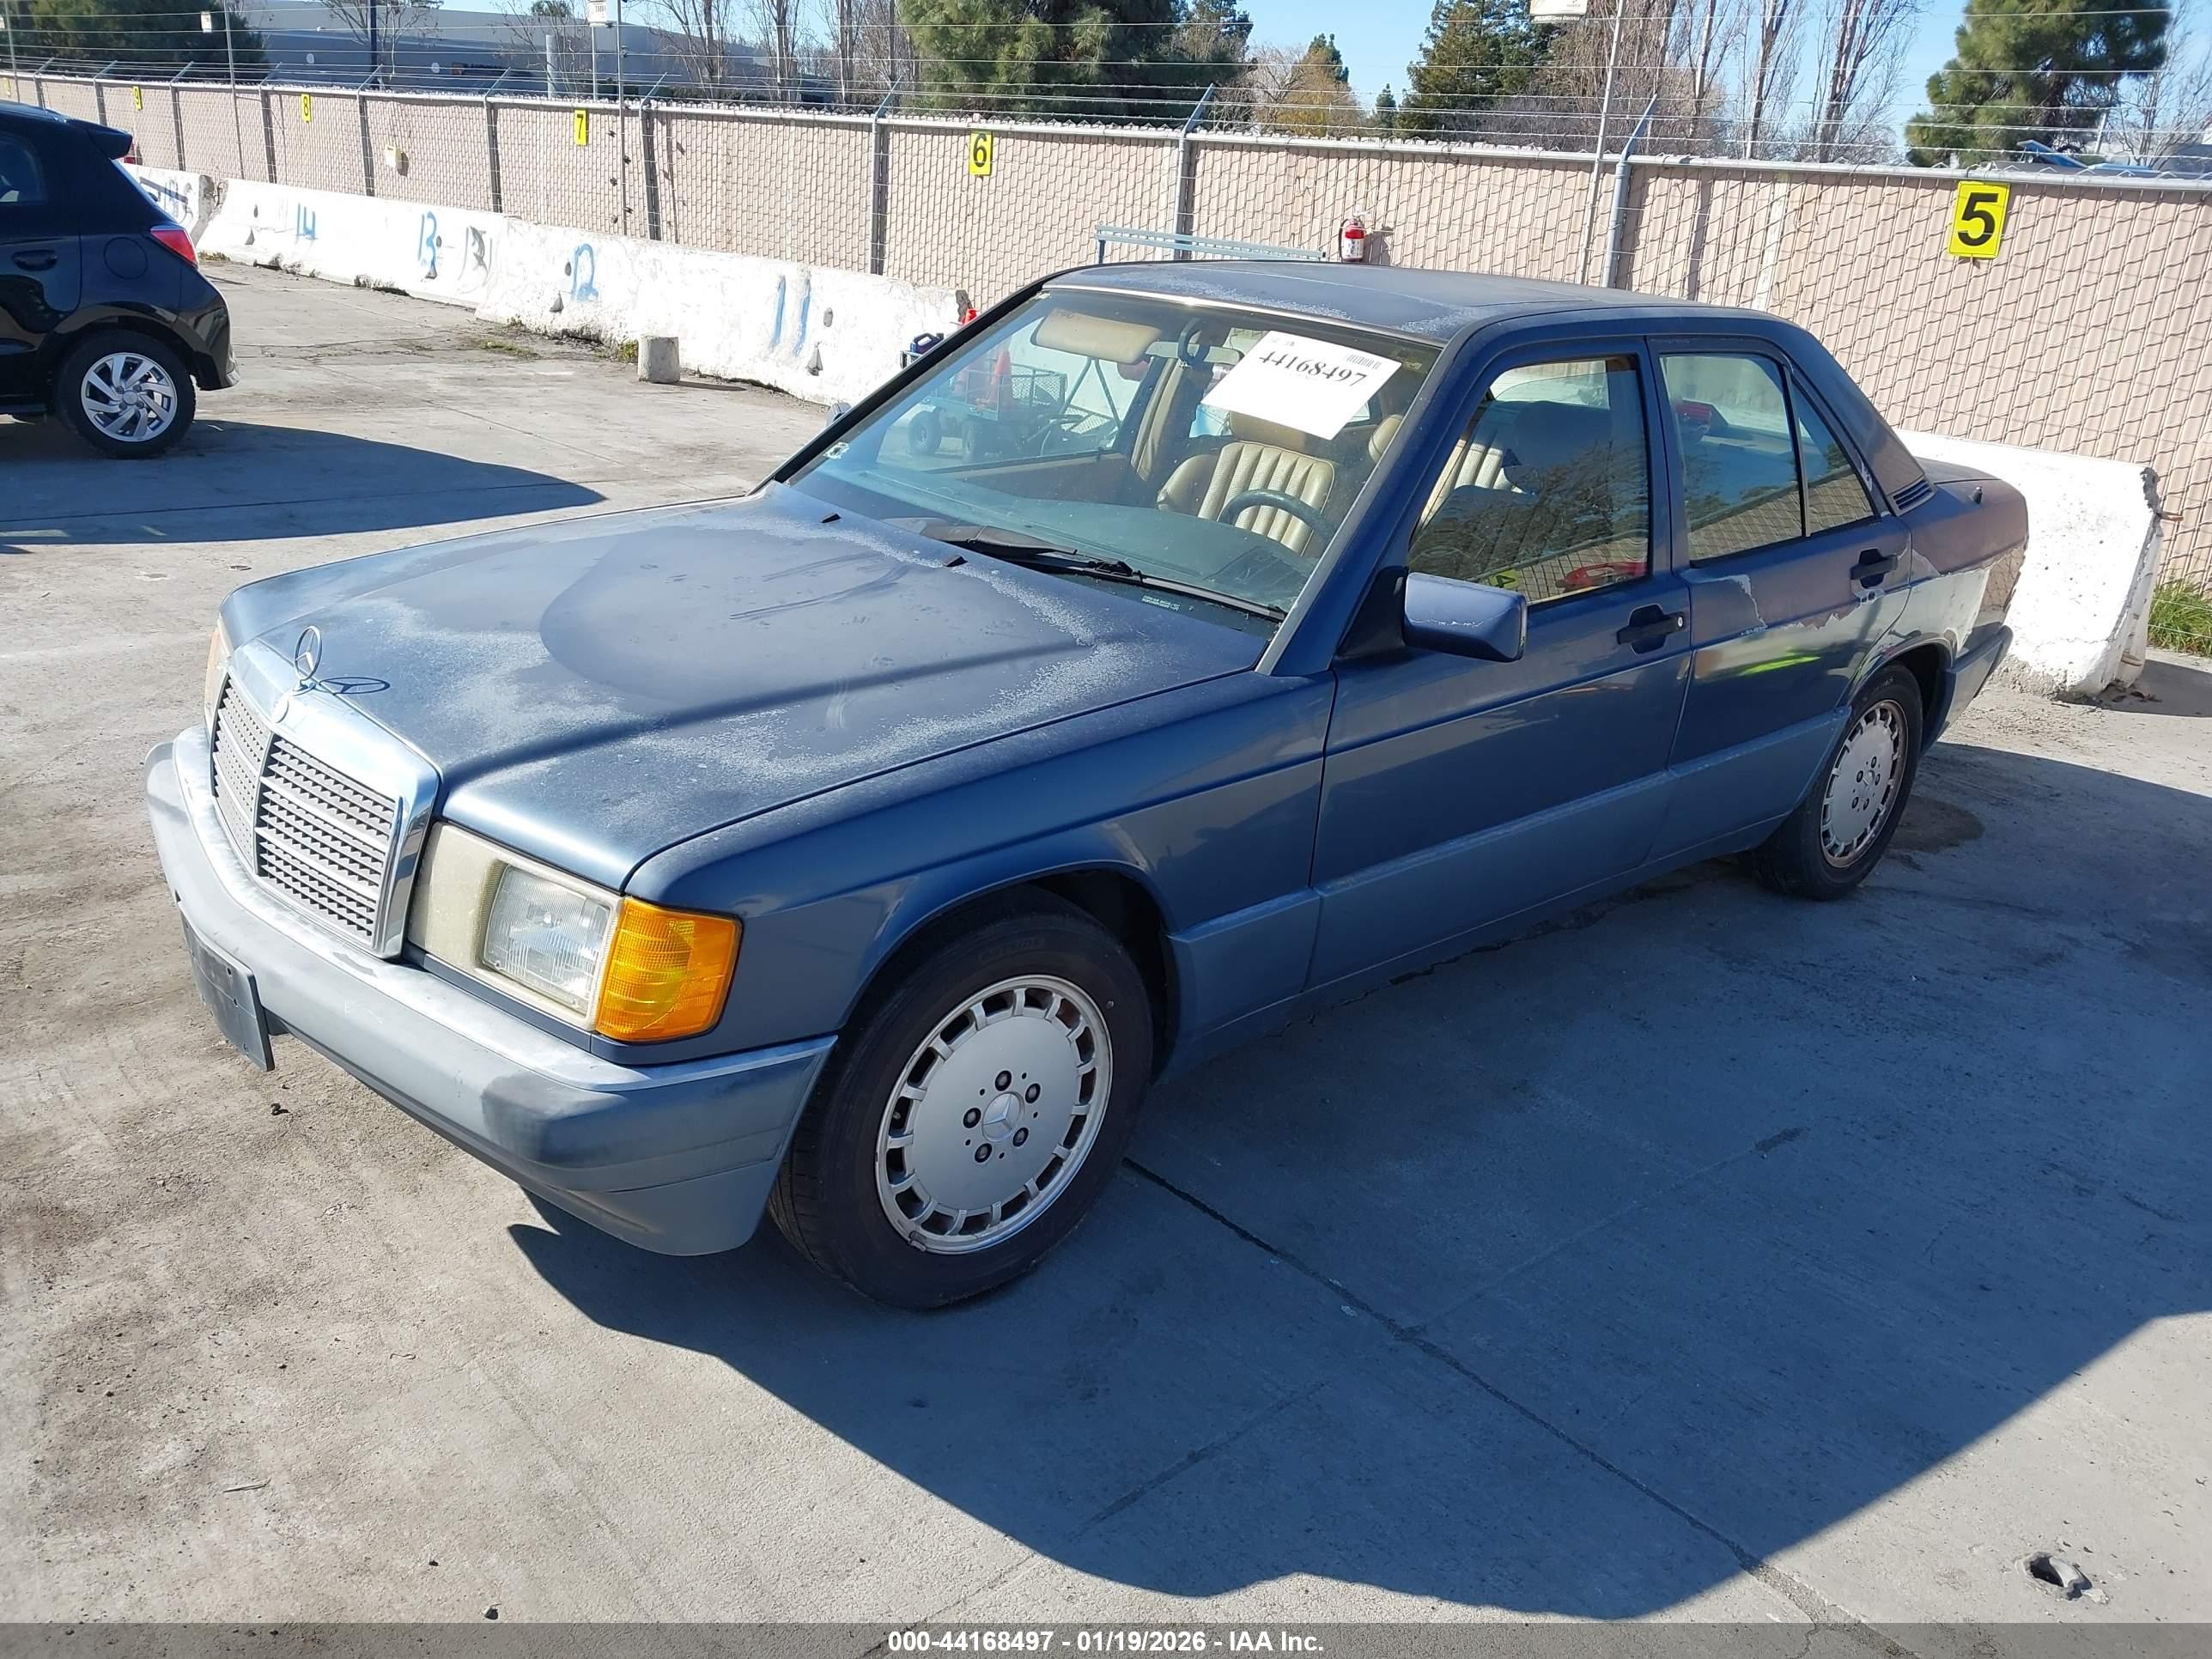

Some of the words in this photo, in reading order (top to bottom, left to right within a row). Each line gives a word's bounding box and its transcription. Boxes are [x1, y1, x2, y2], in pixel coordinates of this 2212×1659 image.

[303, 96, 309, 116] 8
[576, 114, 584, 139] 7
[973, 133, 987, 167] 6
[295, 204, 318, 241] 14
[1958, 192, 1999, 246] 5
[1258, 350, 1368, 386] 44168497
